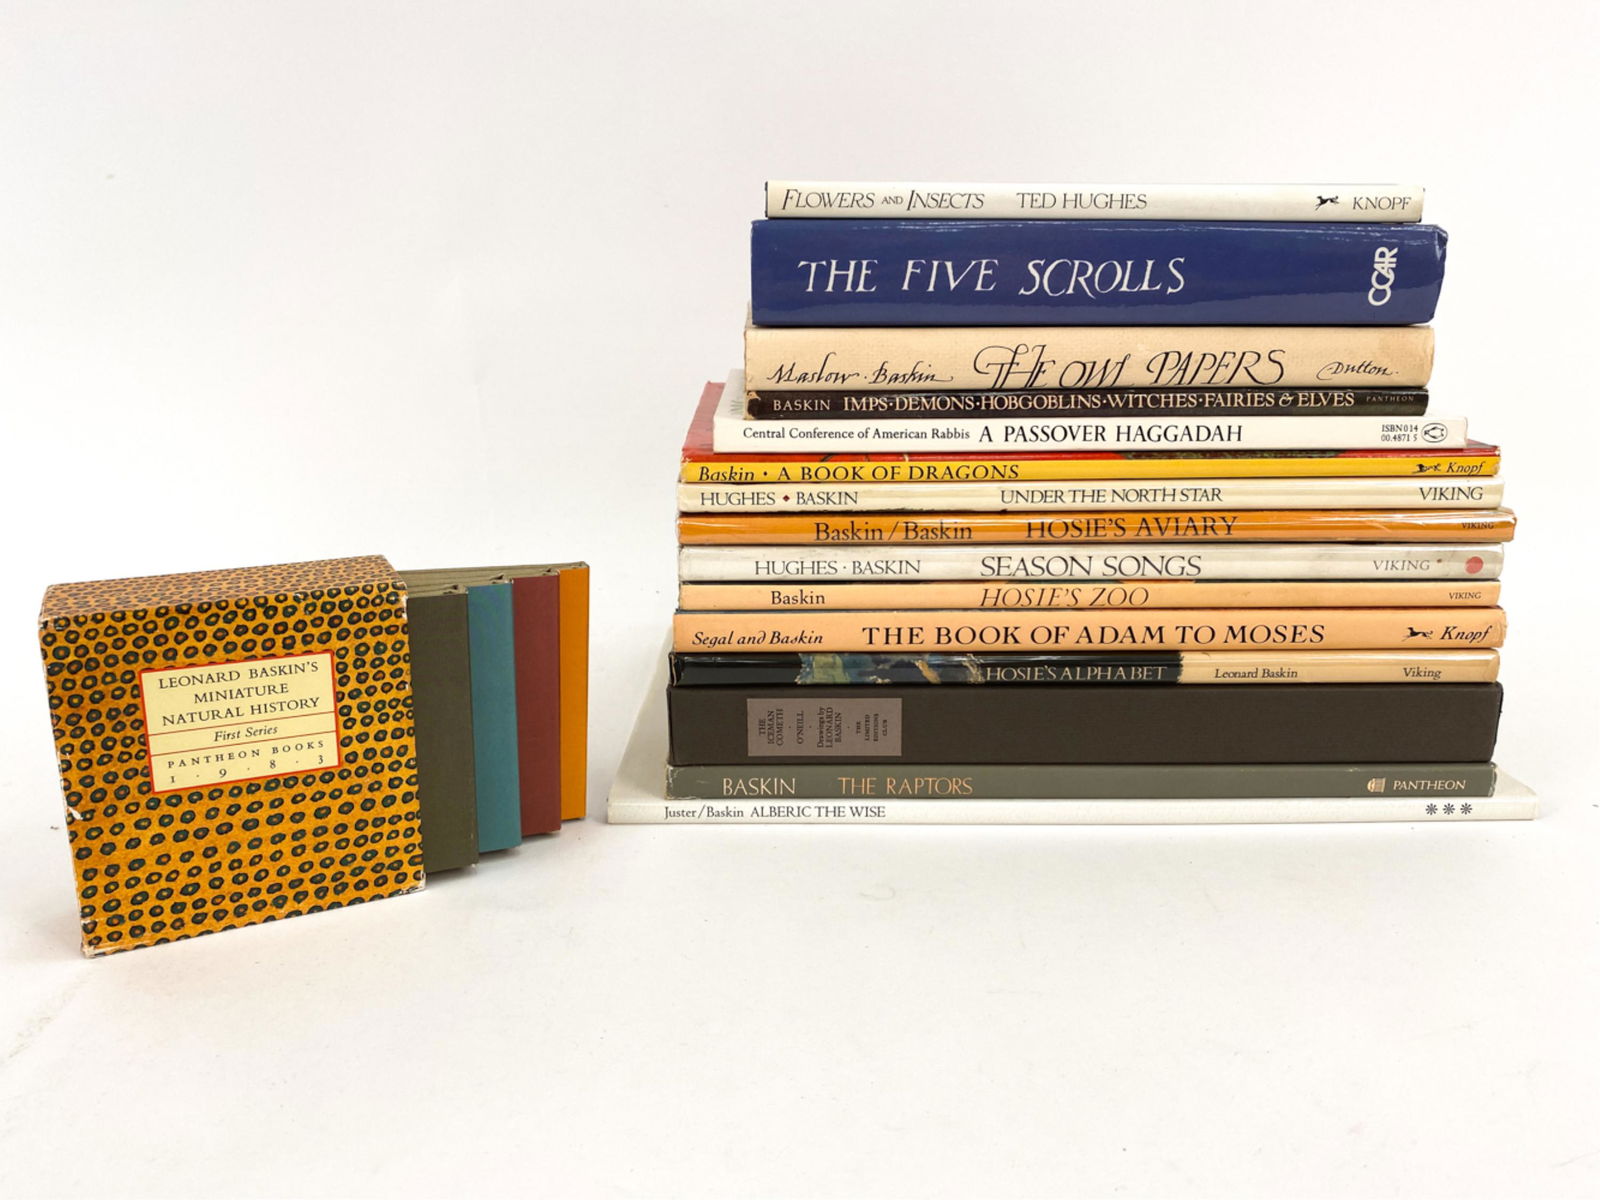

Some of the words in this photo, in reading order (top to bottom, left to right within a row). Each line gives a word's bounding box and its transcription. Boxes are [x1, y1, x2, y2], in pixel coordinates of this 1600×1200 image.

[782, 189, 875, 210] FLOWERS
[881, 195, 904, 205] AND
[906, 190, 985, 211] INSECTS
[1016, 192, 1057, 209] TED
[1063, 193, 1148, 209] HUGHES
[1352, 196, 1412, 211] KNOPF
[798, 259, 878, 292] THE
[901, 259, 999, 292] FIVE
[1018, 257, 1185, 299] SCROLLS
[1367, 246, 1398, 306] CCAR
[767, 352, 859, 384] Maslow
[868, 360, 954, 384] Baskin
[1146, 349, 1286, 386] PAPERS
[773, 399, 831, 411] BASKIN
[1279, 393, 1294, 407] &
[1298, 392, 1355, 407] ELVES
[743, 427, 785, 440] Central
[789, 427, 854, 440] Conference
[858, 427, 870, 439] of
[872, 427, 928, 440] American
[931, 427, 970, 440] Rabbis
[979, 425, 993, 442] A
[1004, 425, 1107, 442] PASSOVER
[1115, 425, 1243, 442] HAGGADAH
[698, 465, 755, 481] Baskin
[777, 466, 791, 480] A
[800, 465, 865, 480] BOOK
[872, 465, 901, 480] OF
[909, 465, 1019, 480] DRAGONS
[1446, 461, 1486, 476] Knopf
[700, 492, 775, 506] HUGHES
[796, 491, 858, 505] BASKIN
[1001, 488, 1066, 503] UNDER
[1068, 488, 1106, 503] THE
[1111, 487, 1176, 503] NORTH
[1181, 488, 1223, 502] STAR
[1419, 486, 1484, 501] VIKING
[1026, 518, 1126, 538] HOSIE'S
[1134, 516, 1238, 537] AVIARY
[1462, 521, 1494, 530] VIKING
[755, 560, 838, 575] HUGHES
[852, 559, 921, 575] BASKIN
[980, 555, 1093, 577] SEASON
[1102, 555, 1202, 577] SONGS
[1373, 559, 1430, 571] VIKING
[771, 590, 826, 605] Baskin
[979, 587, 1083, 607] HOSIE'S
[1089, 587, 1149, 607] ZOO
[1448, 591, 1482, 600] VIKING
[692, 631, 733, 648] Segal
[737, 630, 766, 645] and
[769, 631, 824, 645] Baskin
[862, 626, 925, 645] THE
[935, 626, 1022, 645] BOOK
[1030, 626, 1070, 644] OF
[1075, 625, 1165, 644] ADAM
[1175, 625, 1216, 644] TO
[1223, 624, 1326, 644] MOSES
[1440, 625, 1493, 644] Knopf
[158, 670, 240, 689] LEONARD
[248, 661, 319, 679] BASKIN'S
[986, 665, 1057, 681] HOSIE'S
[1060, 666, 1168, 681] ALPHABET
[1215, 668, 1259, 679] Leonard
[1262, 667, 1298, 679] Baskin
[1402, 667, 1442, 680] Viking
[193, 683, 289, 704] MINIATURE
[162, 706, 244, 727] NATURAL
[250, 697, 320, 715] HISTORY
[214, 729, 241, 742] First
[245, 726, 278, 738] Series
[758, 718, 767, 736] THE
[767, 711, 775, 744] ICEMAN
[776, 708, 784, 746] COMETH
[825, 707, 834, 748] LEONARD
[834, 712, 842, 743] BASKIN
[168, 749, 260, 769] PANTHEON
[272, 740, 324, 755] BOOKS
[722, 777, 796, 796] BASKIN
[837, 777, 877, 795] THE
[885, 777, 974, 795] RAPTORS
[1393, 780, 1466, 790] PANTHEON
[750, 805, 812, 818] ALBERIC
[814, 806, 846, 818] THE
[850, 806, 886, 818] WISE
